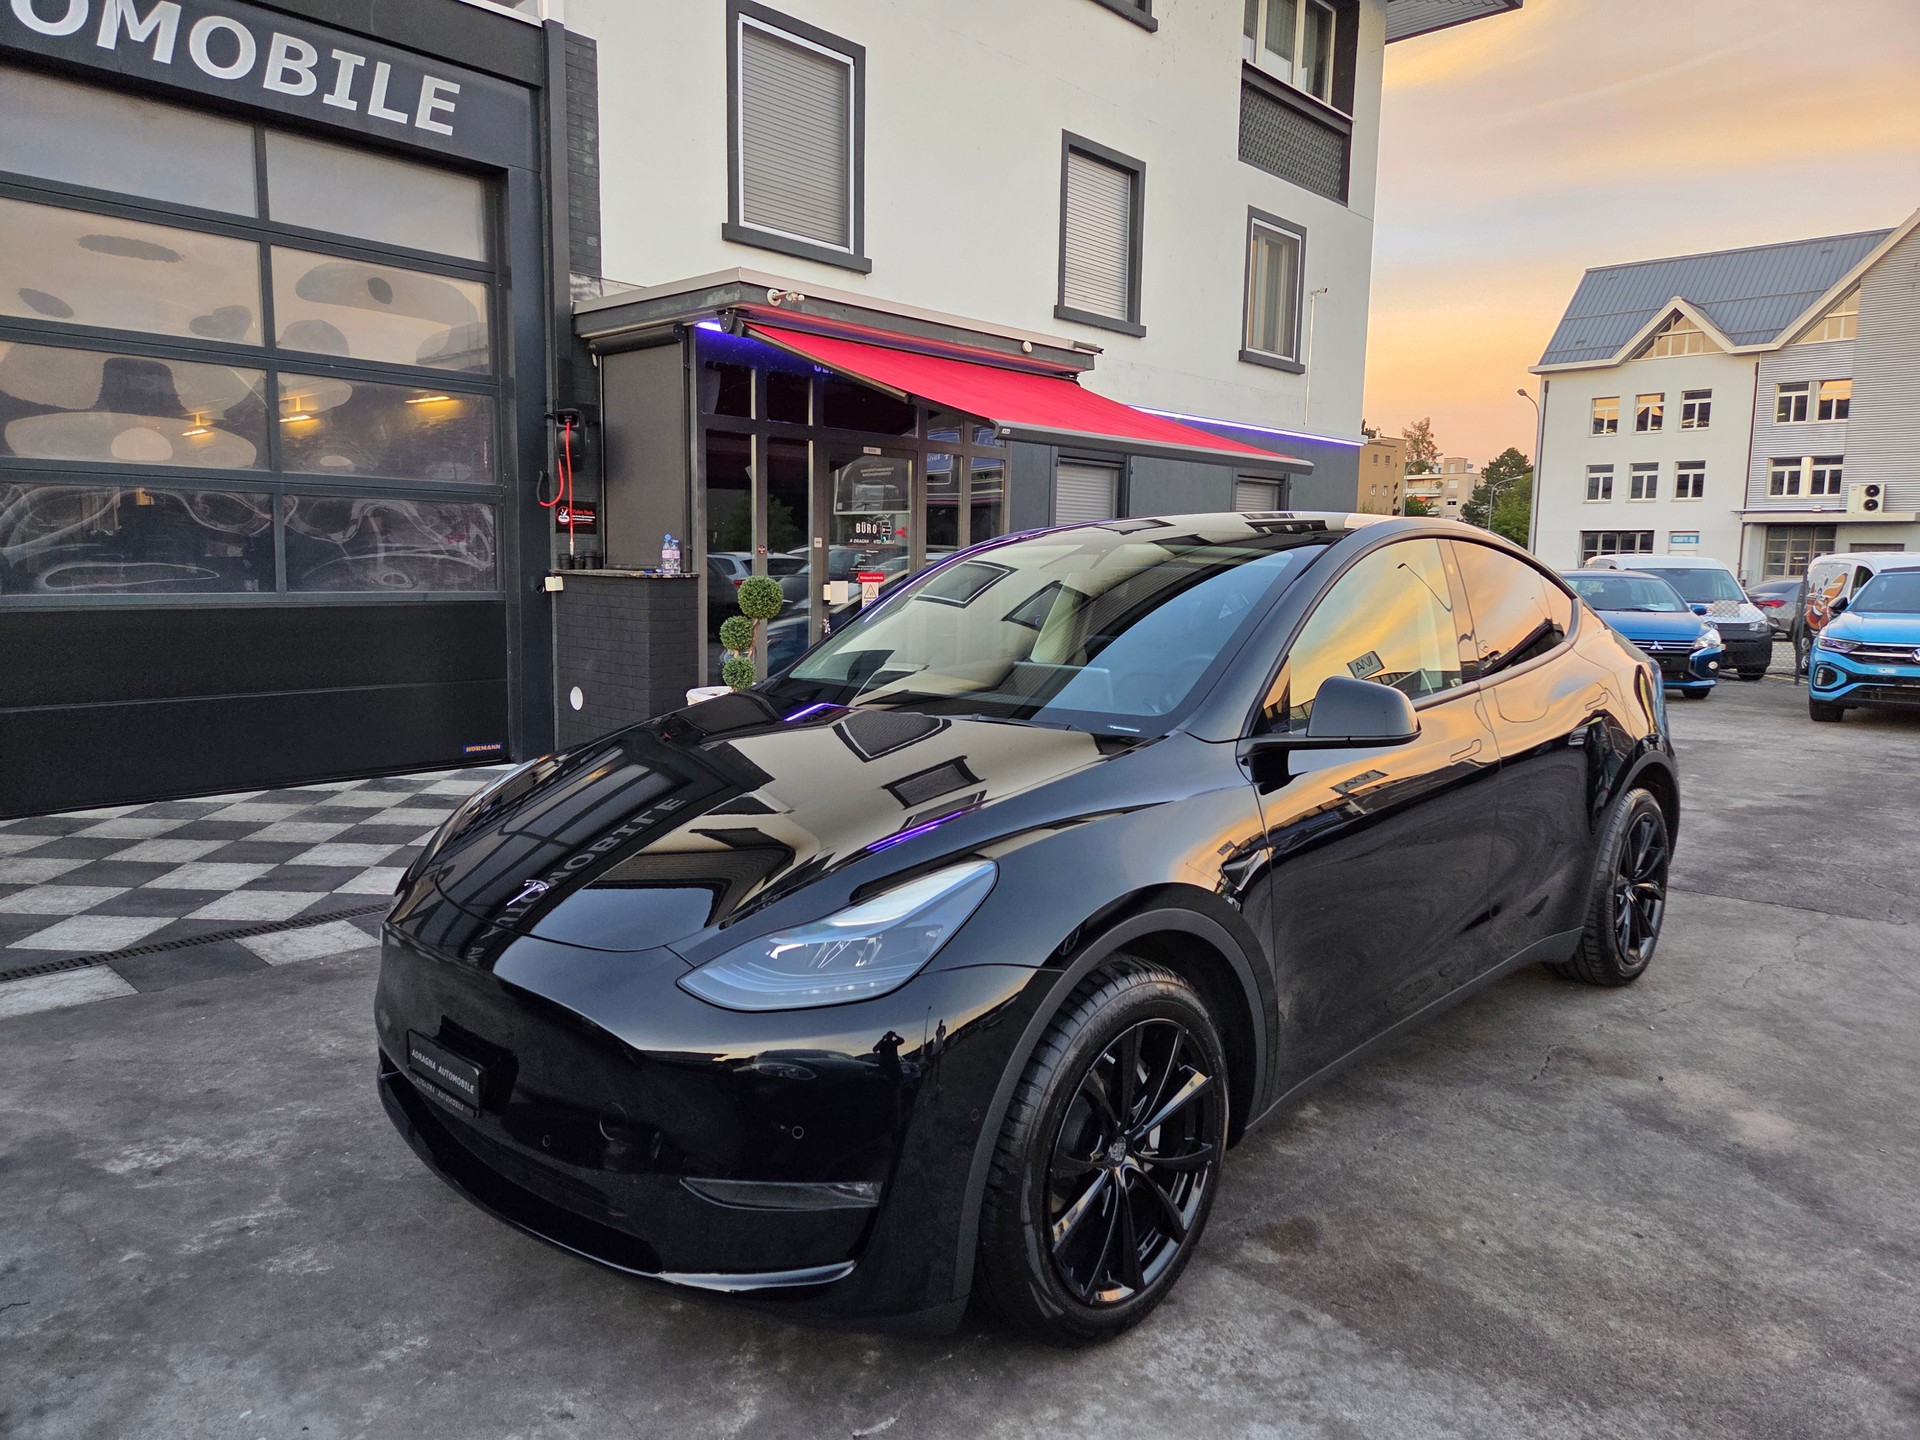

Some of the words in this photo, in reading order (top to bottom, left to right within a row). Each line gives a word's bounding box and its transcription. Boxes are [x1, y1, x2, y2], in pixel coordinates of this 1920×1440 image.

[855, 521, 878, 534] BÜRO
[411, 1048, 436, 1071] ADRAGNA
[437, 1065, 475, 1094] AUTOMOBILE
